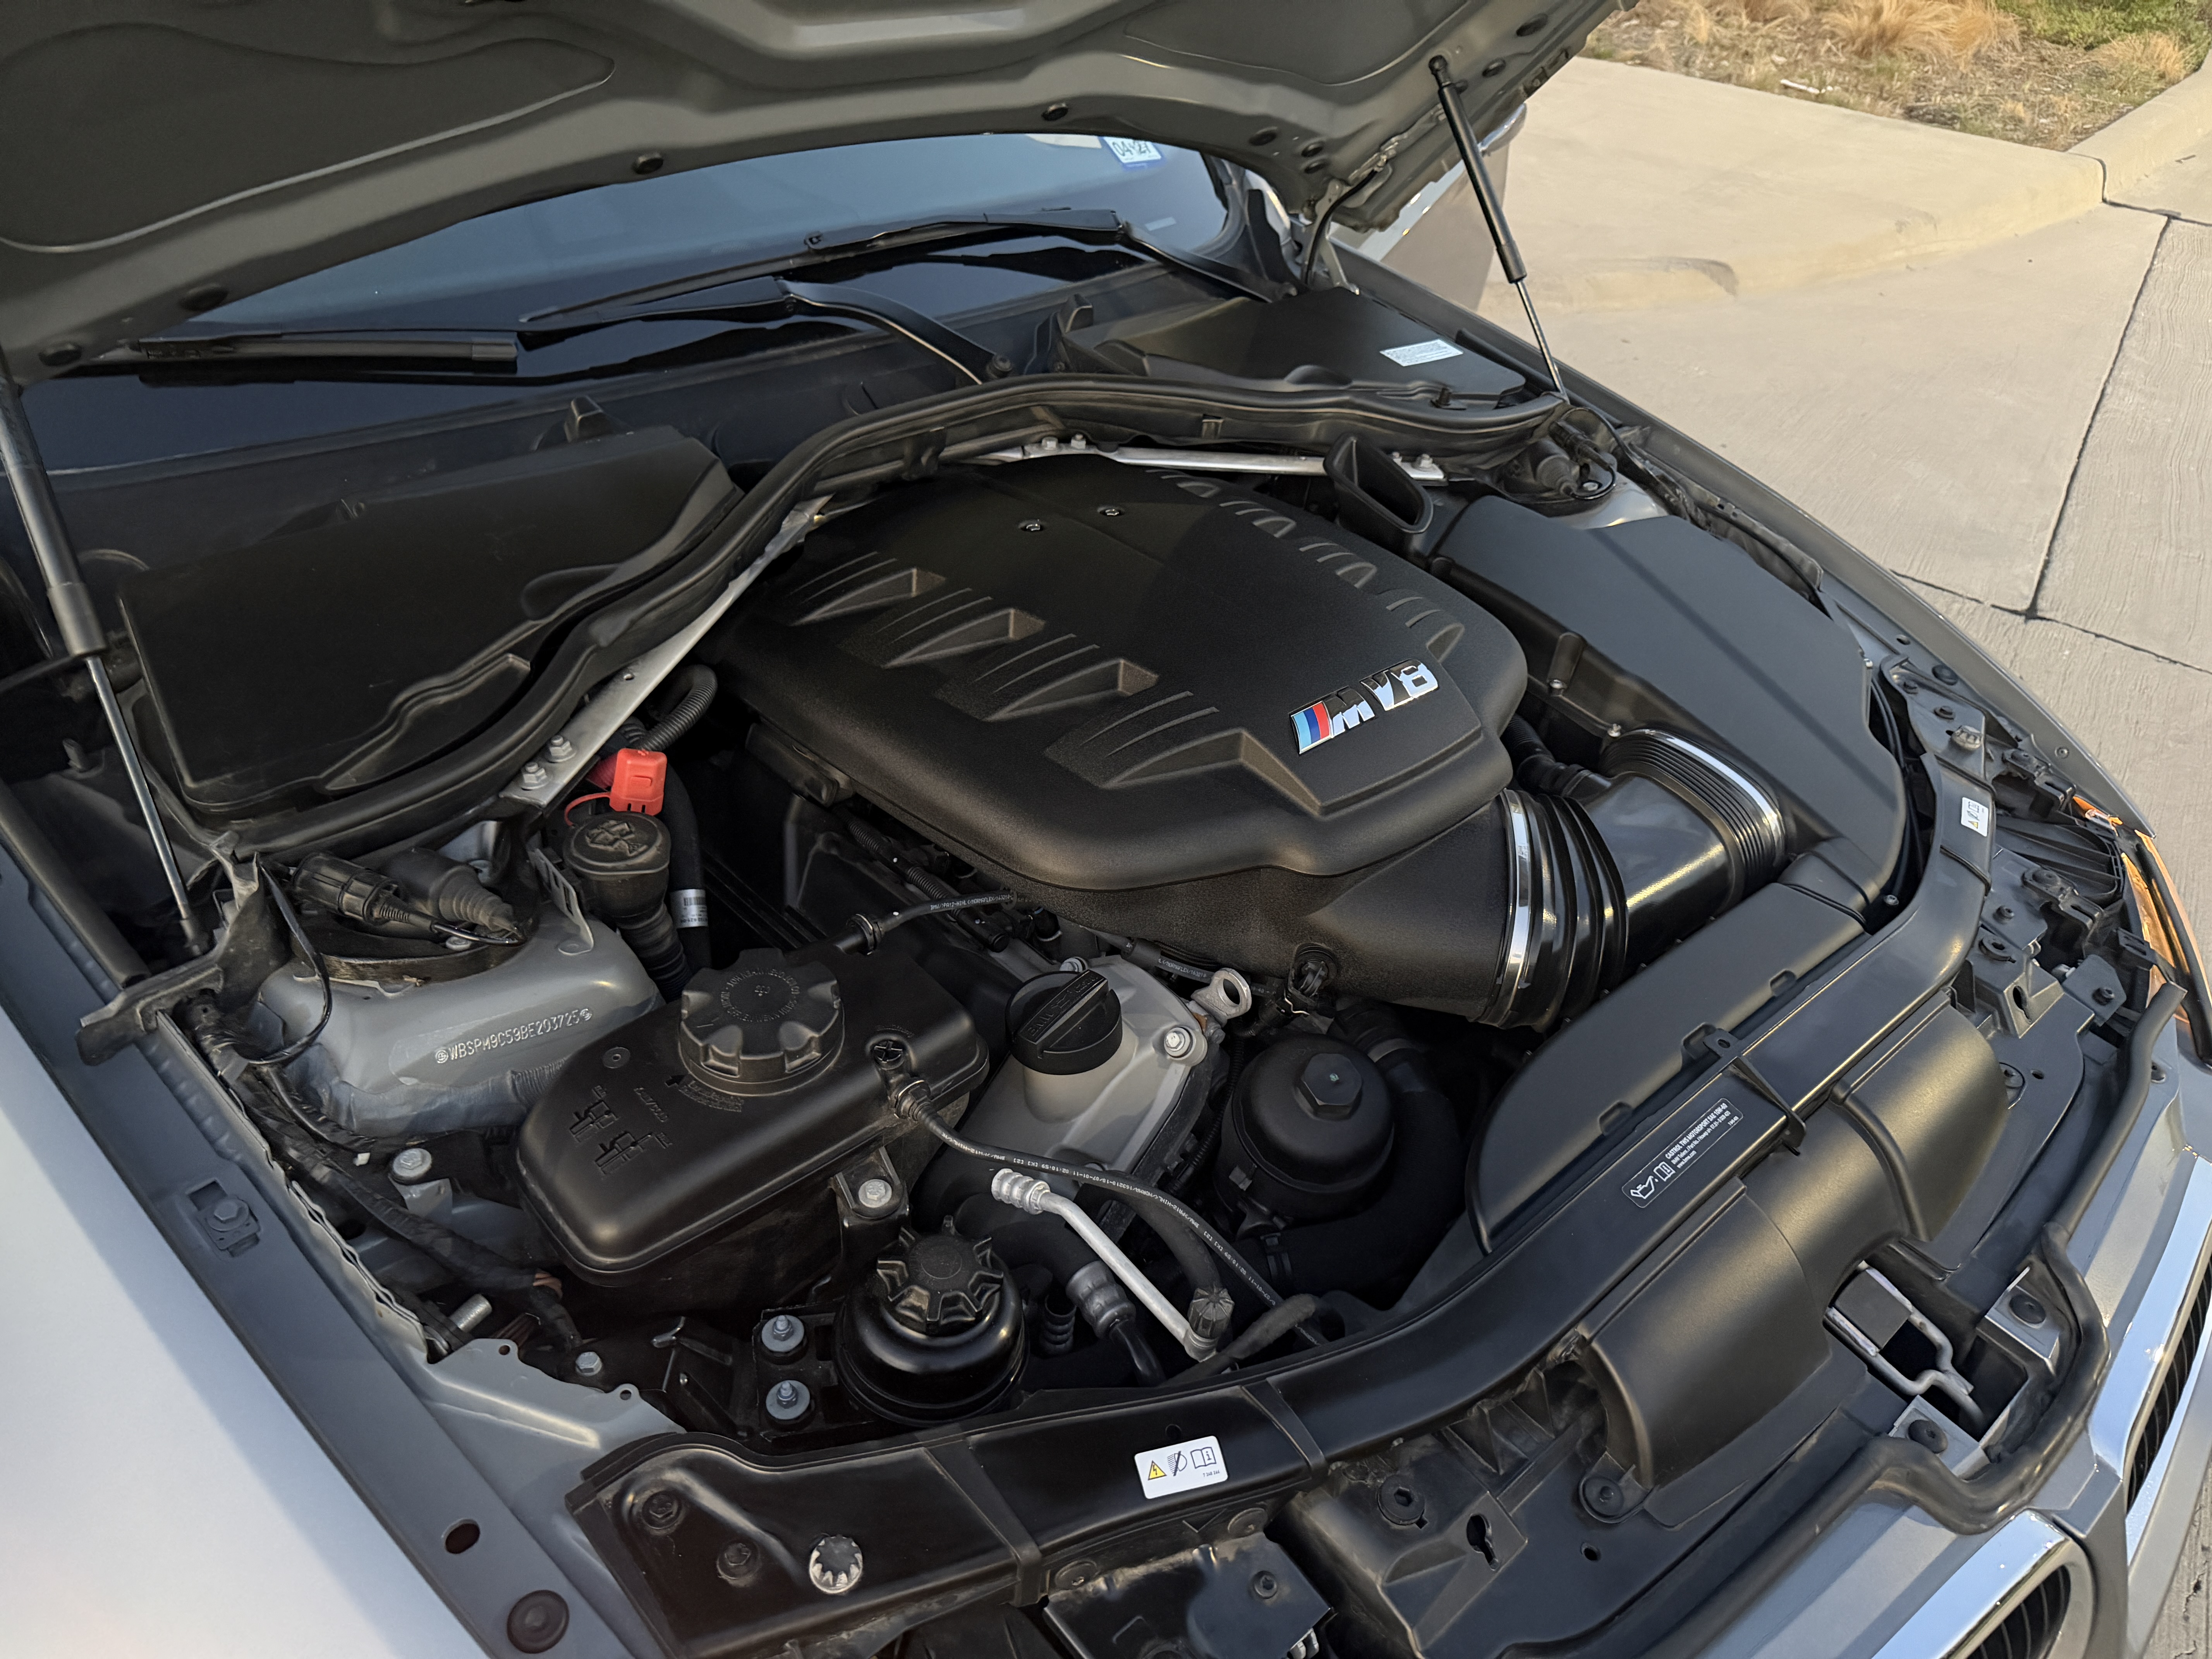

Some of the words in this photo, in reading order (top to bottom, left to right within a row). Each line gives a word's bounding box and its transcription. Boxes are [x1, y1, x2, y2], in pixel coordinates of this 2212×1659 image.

[1112, 141, 1133, 156] 04
[1359, 659, 1439, 711] V8
[1665, 1144, 1682, 1159] CASTROL
[1679, 1137, 1689, 1146] TWS
[1686, 1118, 1710, 1140] MOTORSPORT
[1707, 1113, 1716, 1121] SAE
[1714, 1103, 1728, 1115] 10W-60
[1671, 1156, 1680, 1164] BMW
